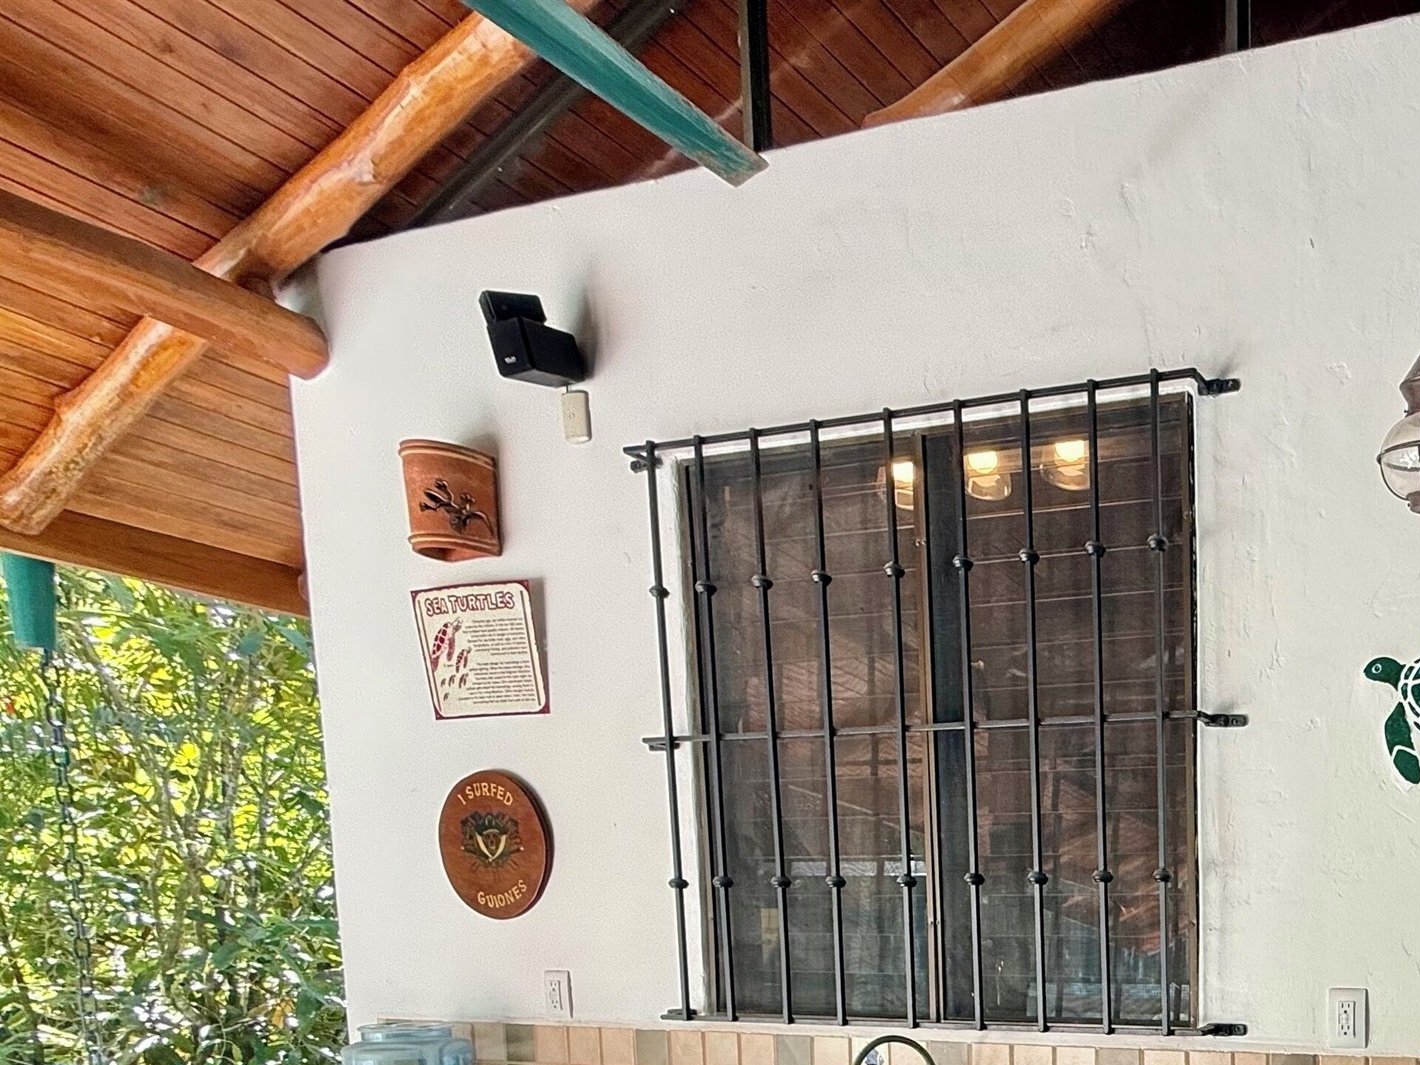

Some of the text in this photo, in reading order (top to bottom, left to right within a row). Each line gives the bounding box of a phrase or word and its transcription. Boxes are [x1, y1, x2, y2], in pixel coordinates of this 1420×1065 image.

[425, 591, 515, 616] SEA TURTLES
[457, 782, 514, 806] I SURFED
[477, 879, 527, 908] GUIONES
